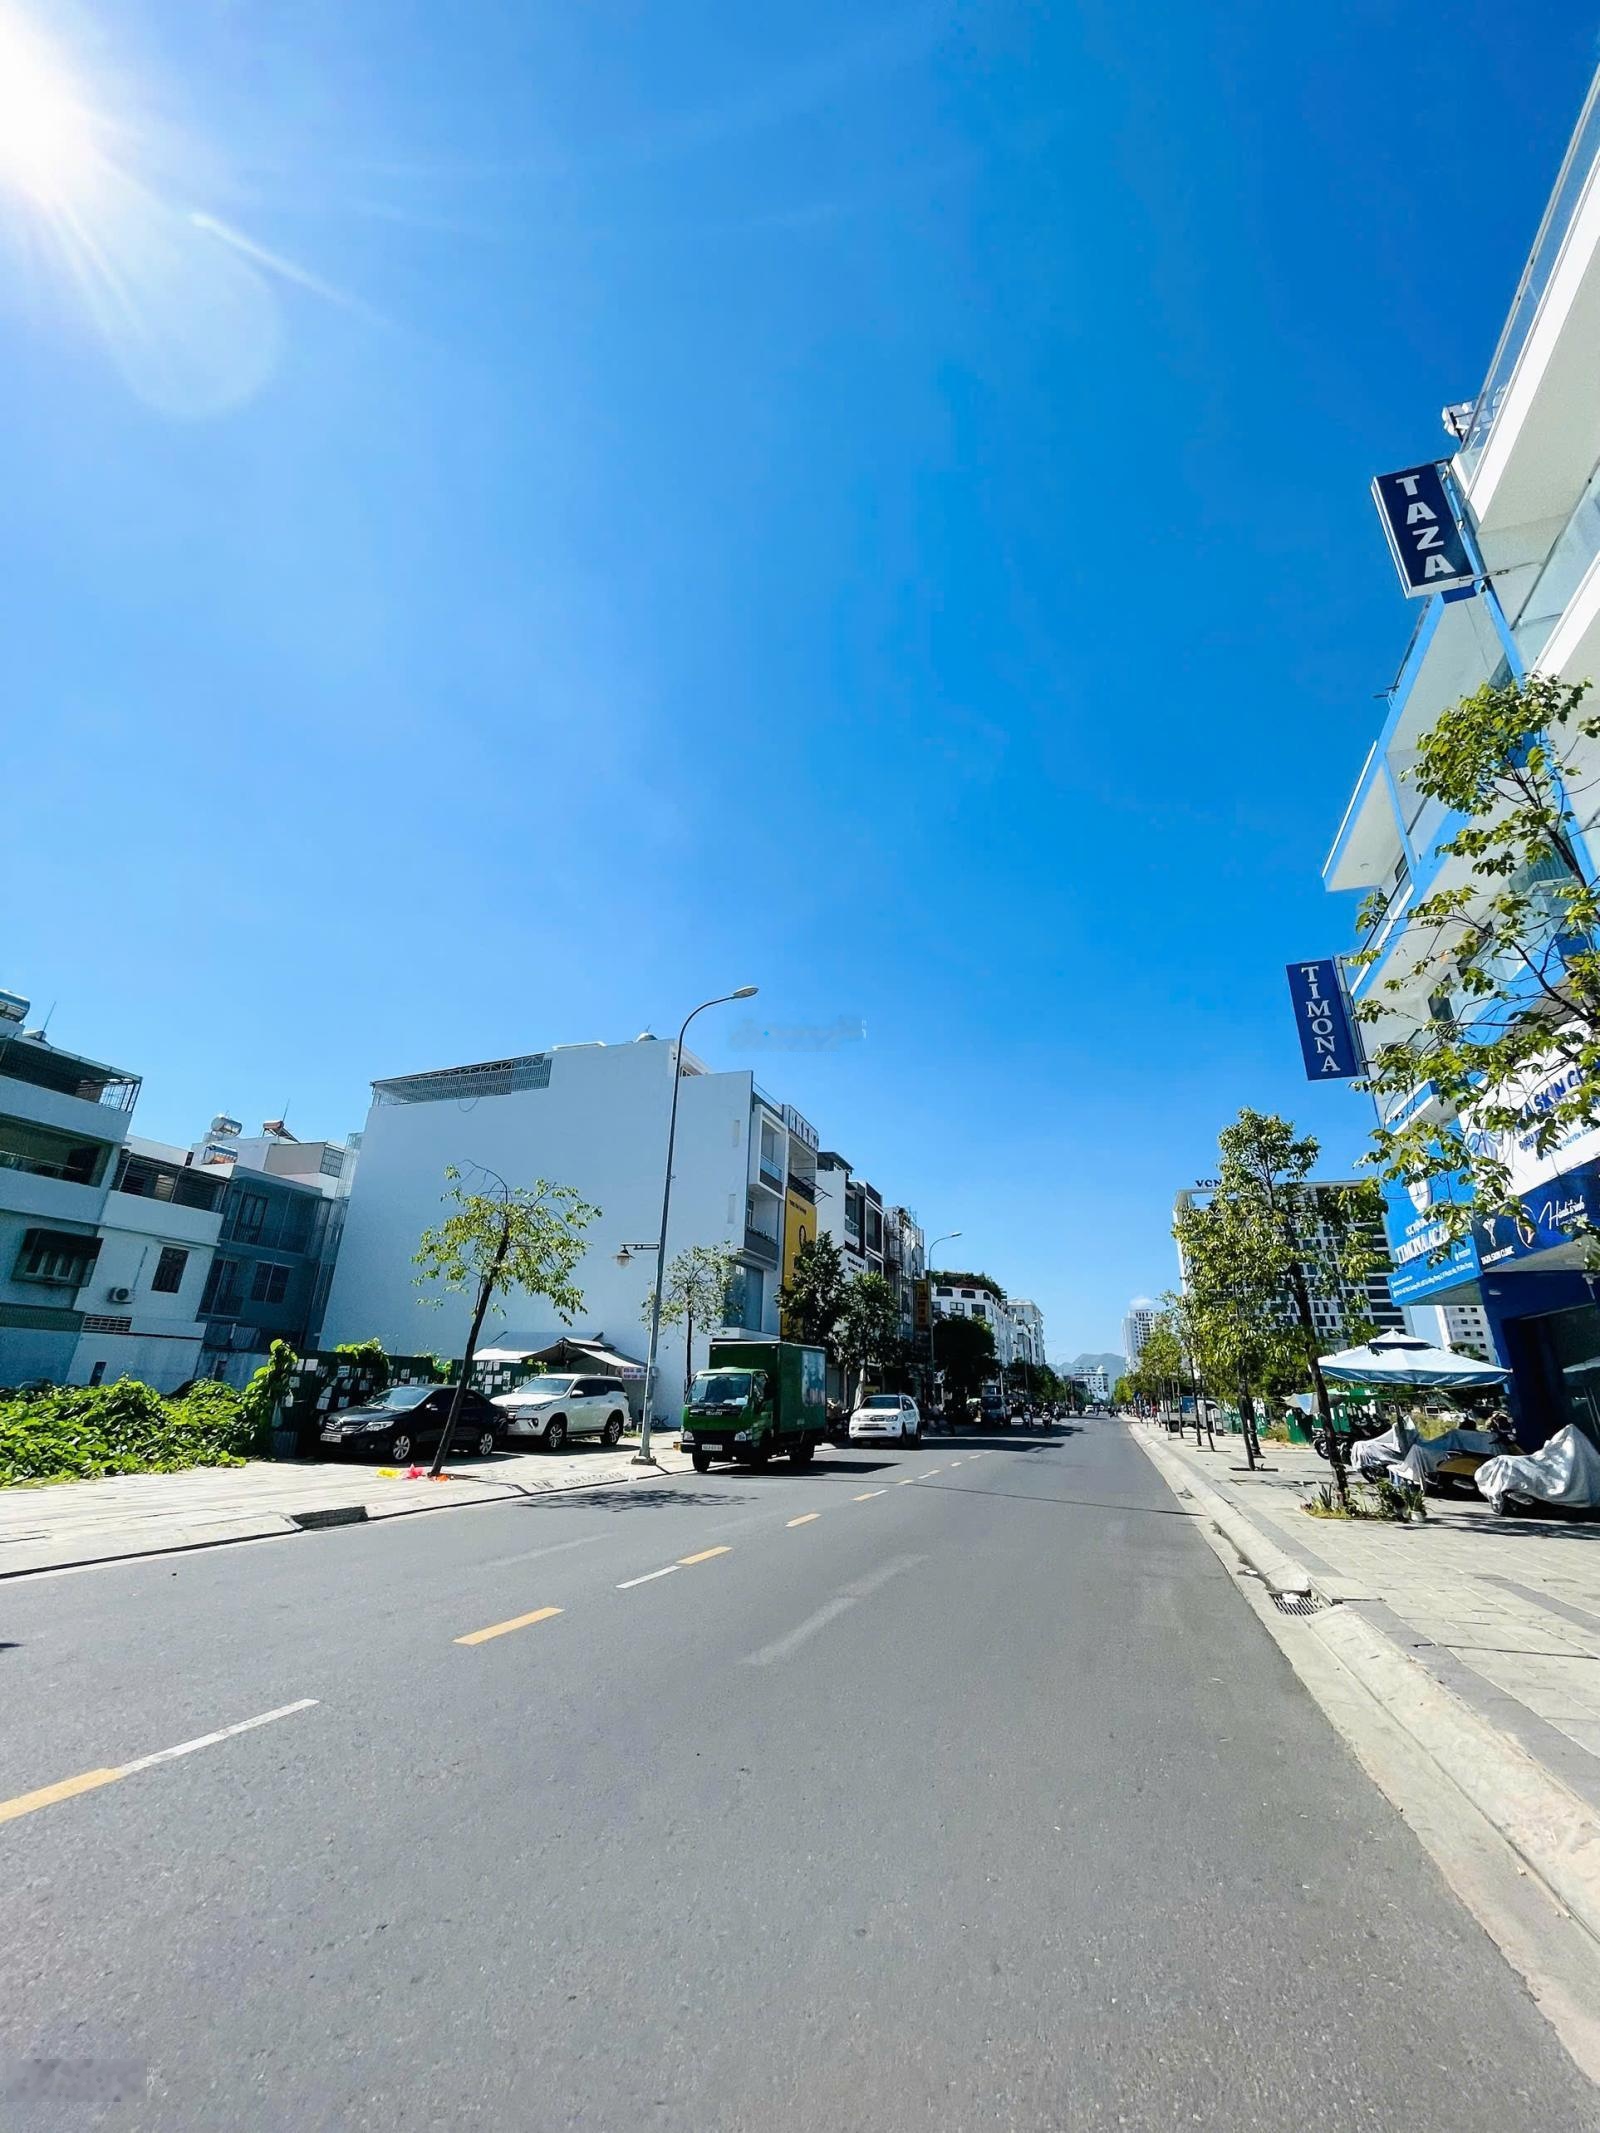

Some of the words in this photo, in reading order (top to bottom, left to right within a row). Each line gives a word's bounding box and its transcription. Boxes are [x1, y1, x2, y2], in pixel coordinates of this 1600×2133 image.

[1395, 475, 1456, 578] TAZA
[1301, 966, 1341, 1072] TIMONA
[1395, 1234, 1426, 1264] TIMONA
